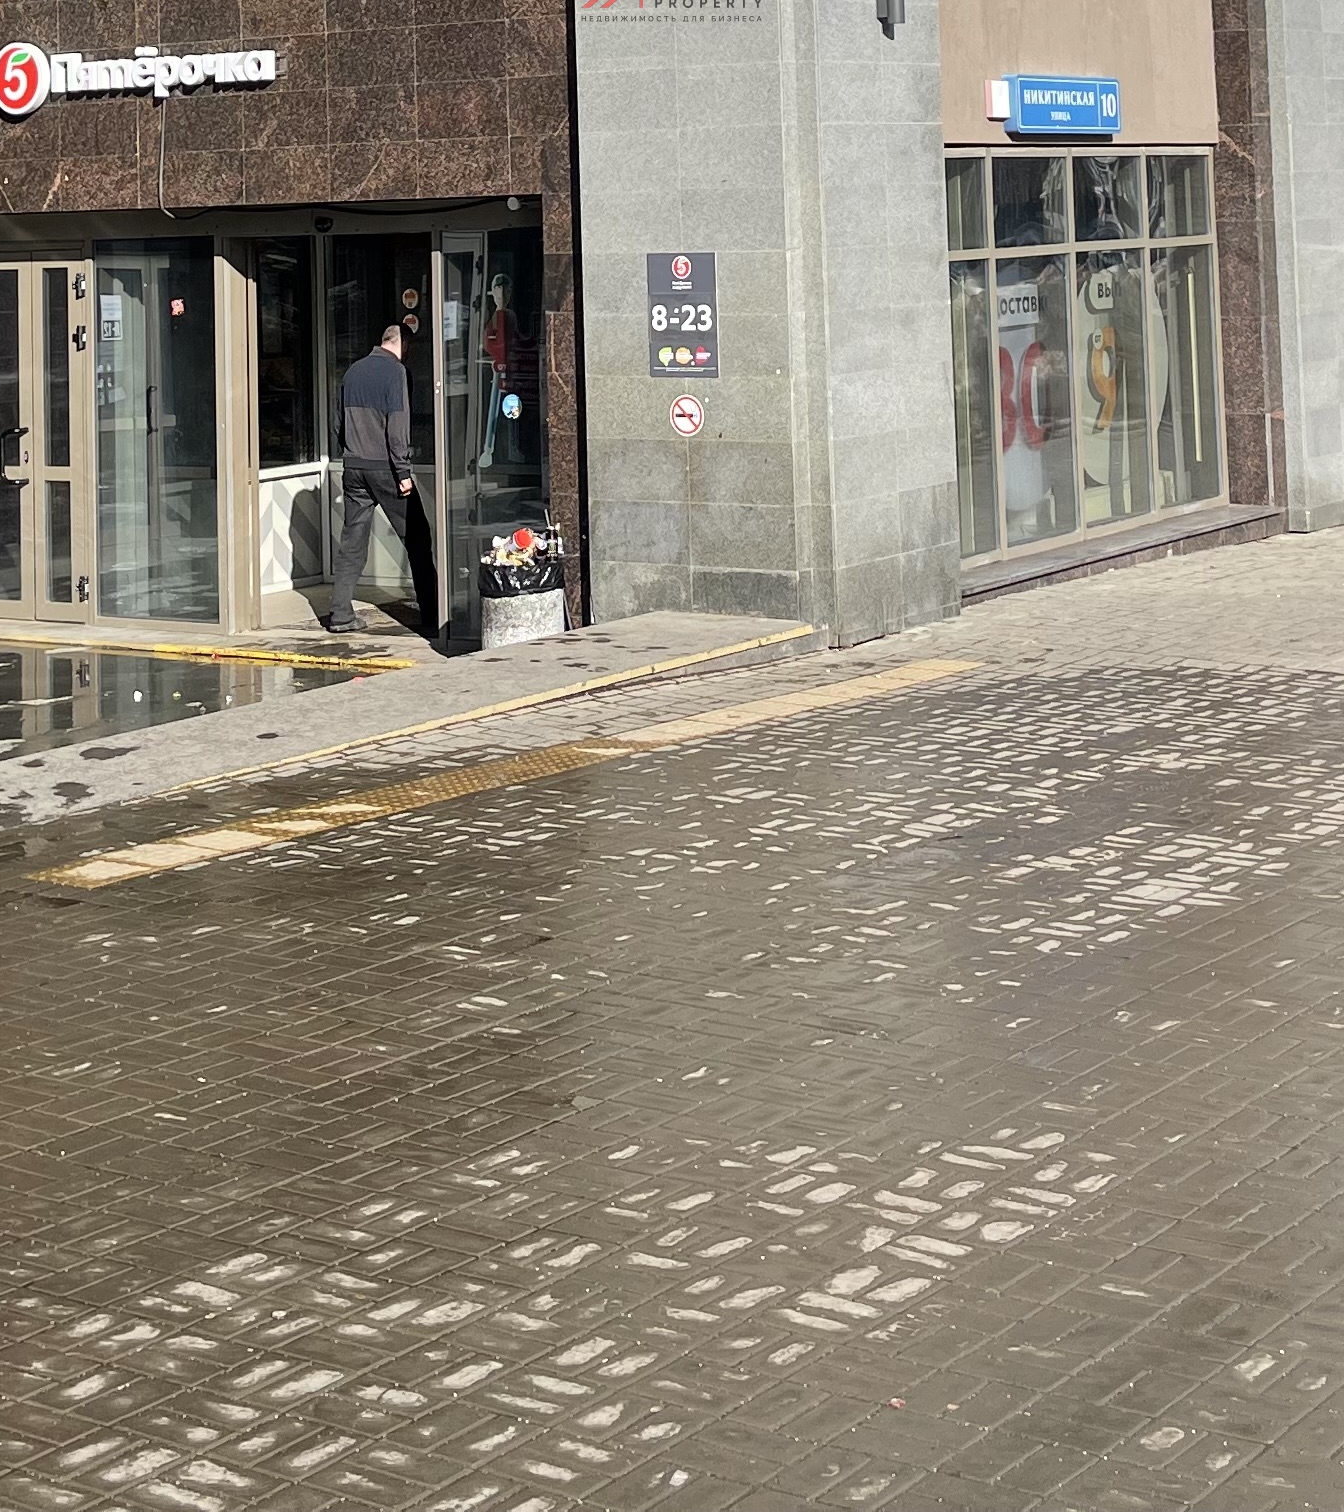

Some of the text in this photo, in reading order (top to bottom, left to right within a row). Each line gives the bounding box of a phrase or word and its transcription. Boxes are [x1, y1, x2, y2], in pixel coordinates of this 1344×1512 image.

[50, 46, 276, 98] Пятёрочка
[1023, 89, 1117, 118] НИКИТИНСКАЯ 10
[651, 304, 713, 332] 8-23
